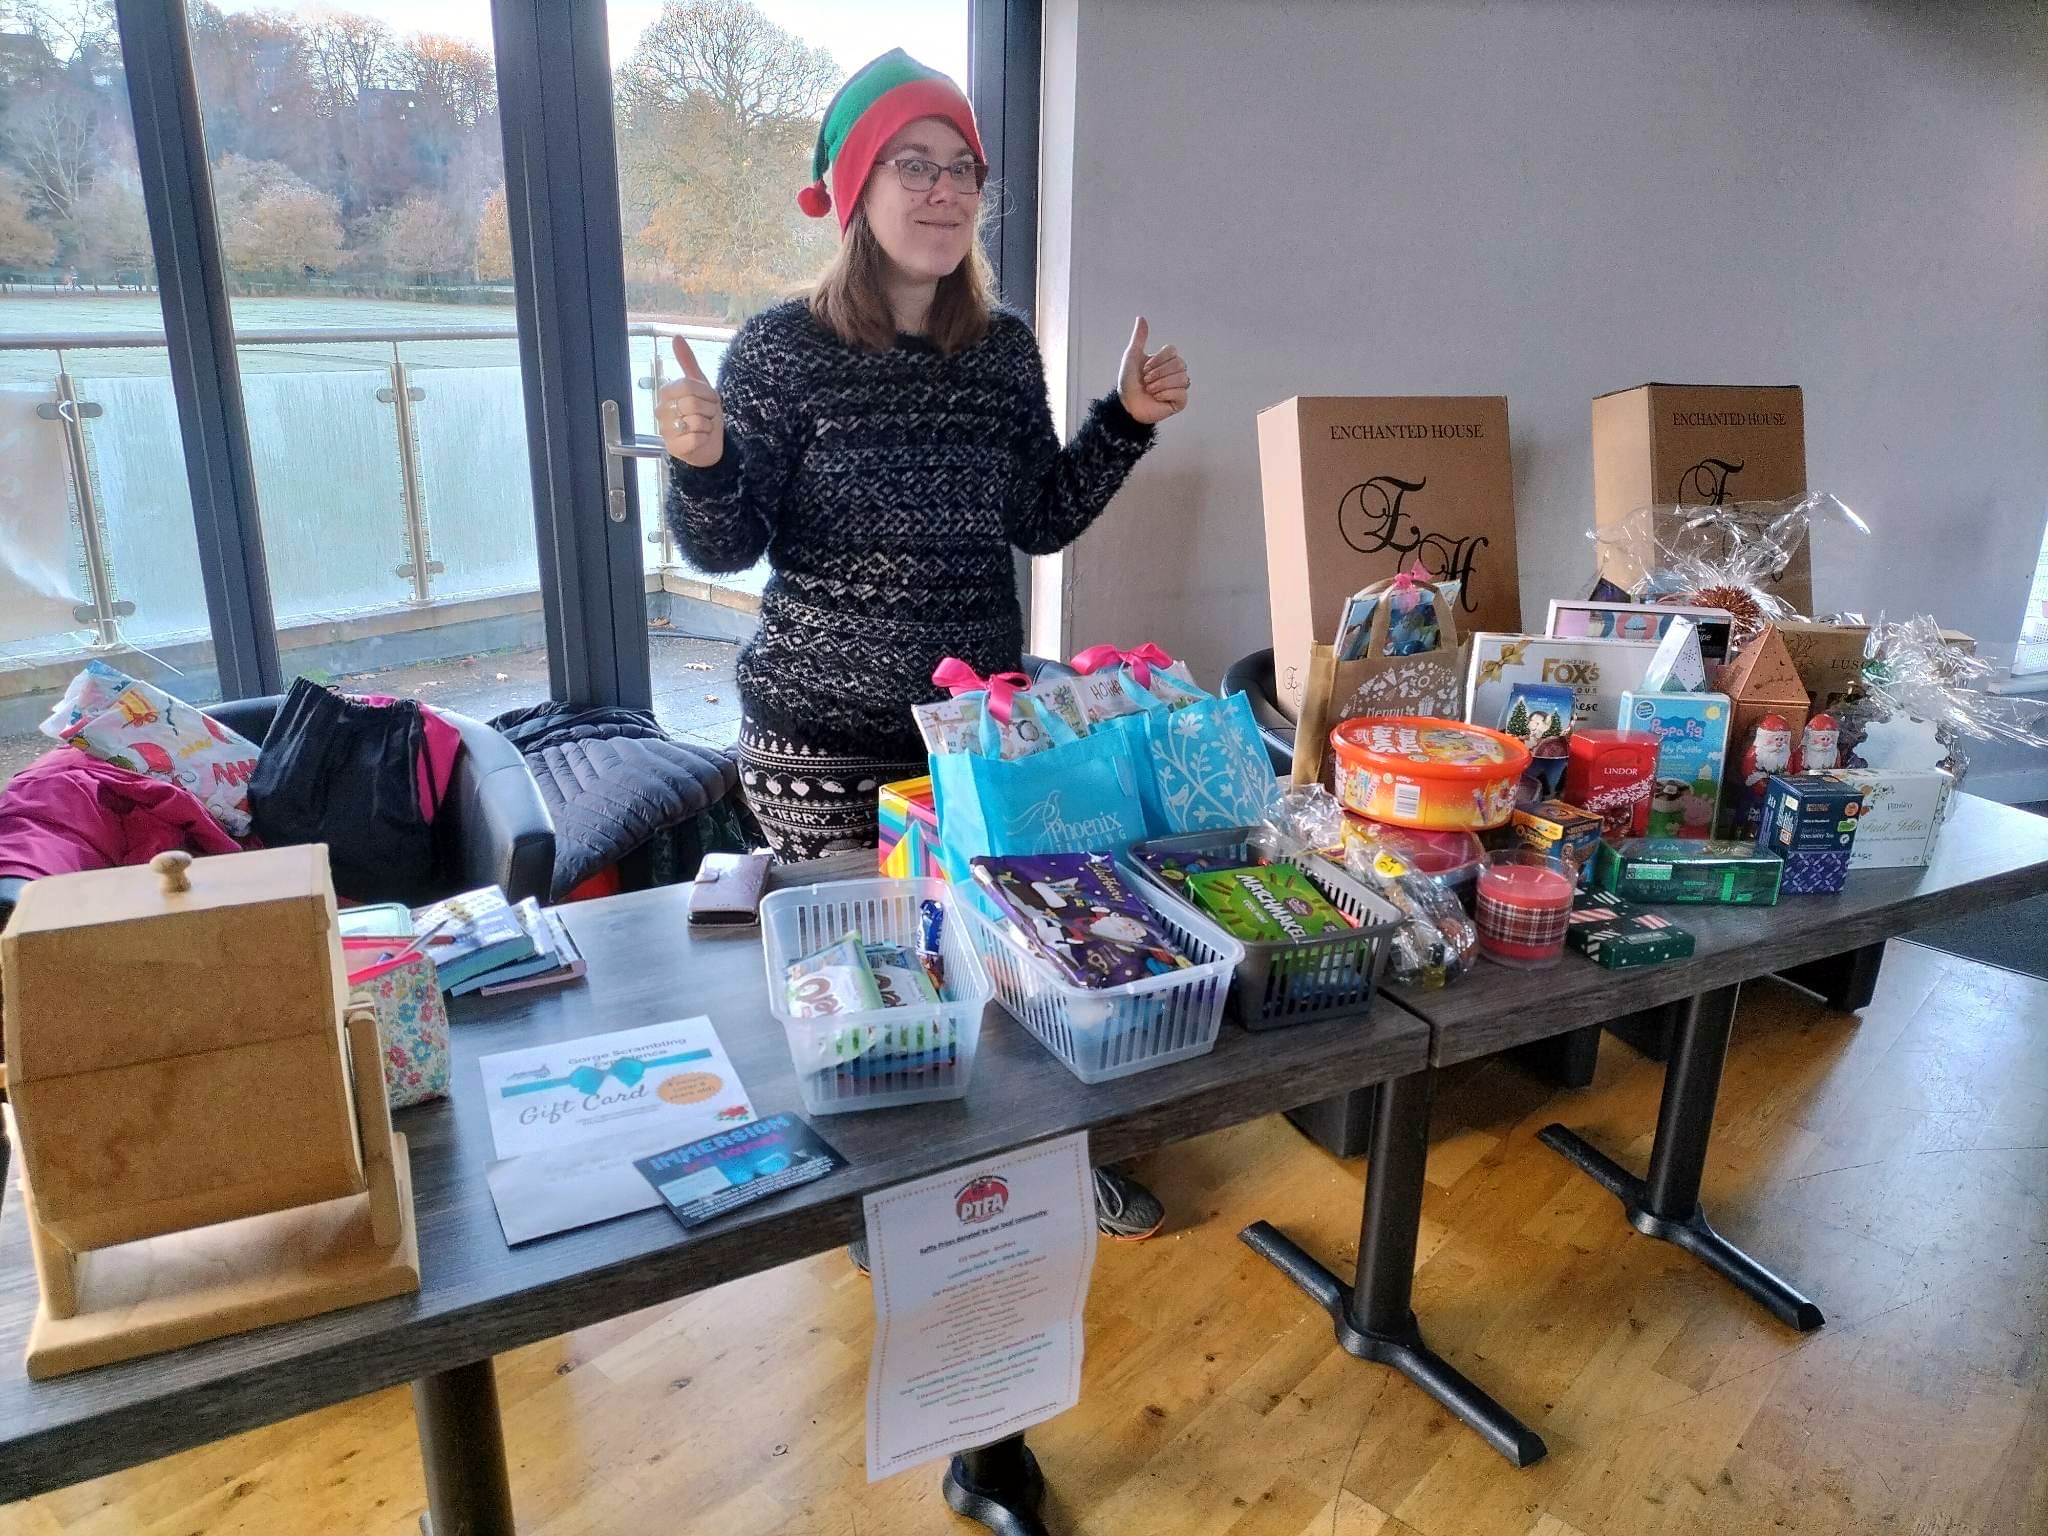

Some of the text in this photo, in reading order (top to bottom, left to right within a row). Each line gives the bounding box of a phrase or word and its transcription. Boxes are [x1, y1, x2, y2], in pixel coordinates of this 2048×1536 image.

[1673, 412, 1787, 426] ENCHANTED HOUSE
[1330, 424, 1484, 440] ENCHANTED HOUSE
[1651, 718, 1703, 738] Peppa Pig
[1603, 767, 1638, 776] LINDOR
[1047, 811, 1123, 843] Phoenix
[1235, 873, 1308, 941] MATCHMAKE
[568, 1038, 688, 1066] Gorge Scrambling
[518, 1098, 577, 1126] Gift
[581, 1084, 650, 1112] Card
